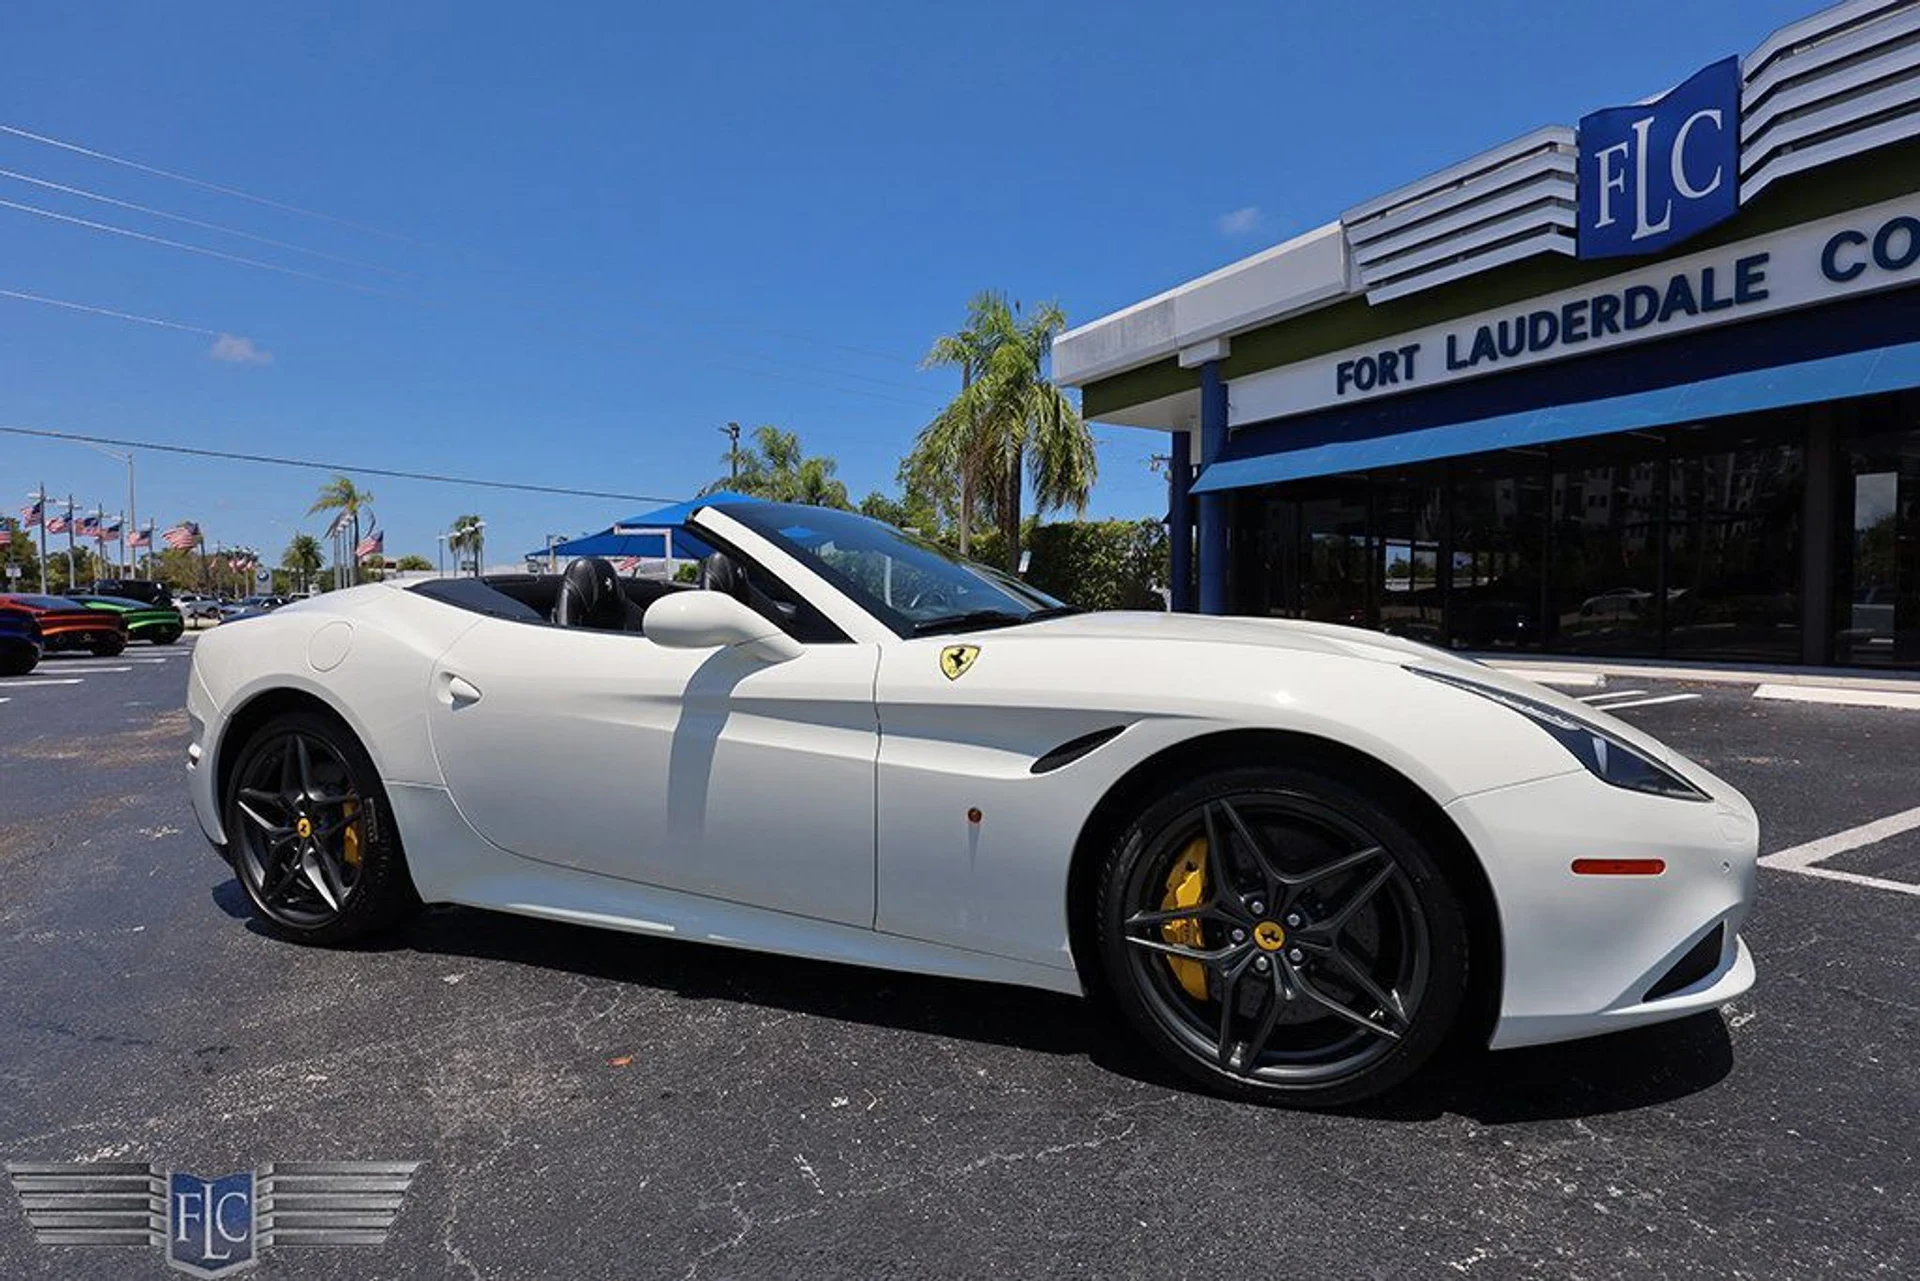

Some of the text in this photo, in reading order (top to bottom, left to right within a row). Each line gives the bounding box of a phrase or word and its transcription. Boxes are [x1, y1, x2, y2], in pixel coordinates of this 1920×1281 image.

[1594, 108, 1724, 241] FLC
[1337, 216, 1920, 395] FORT LAUDERDALE CO
